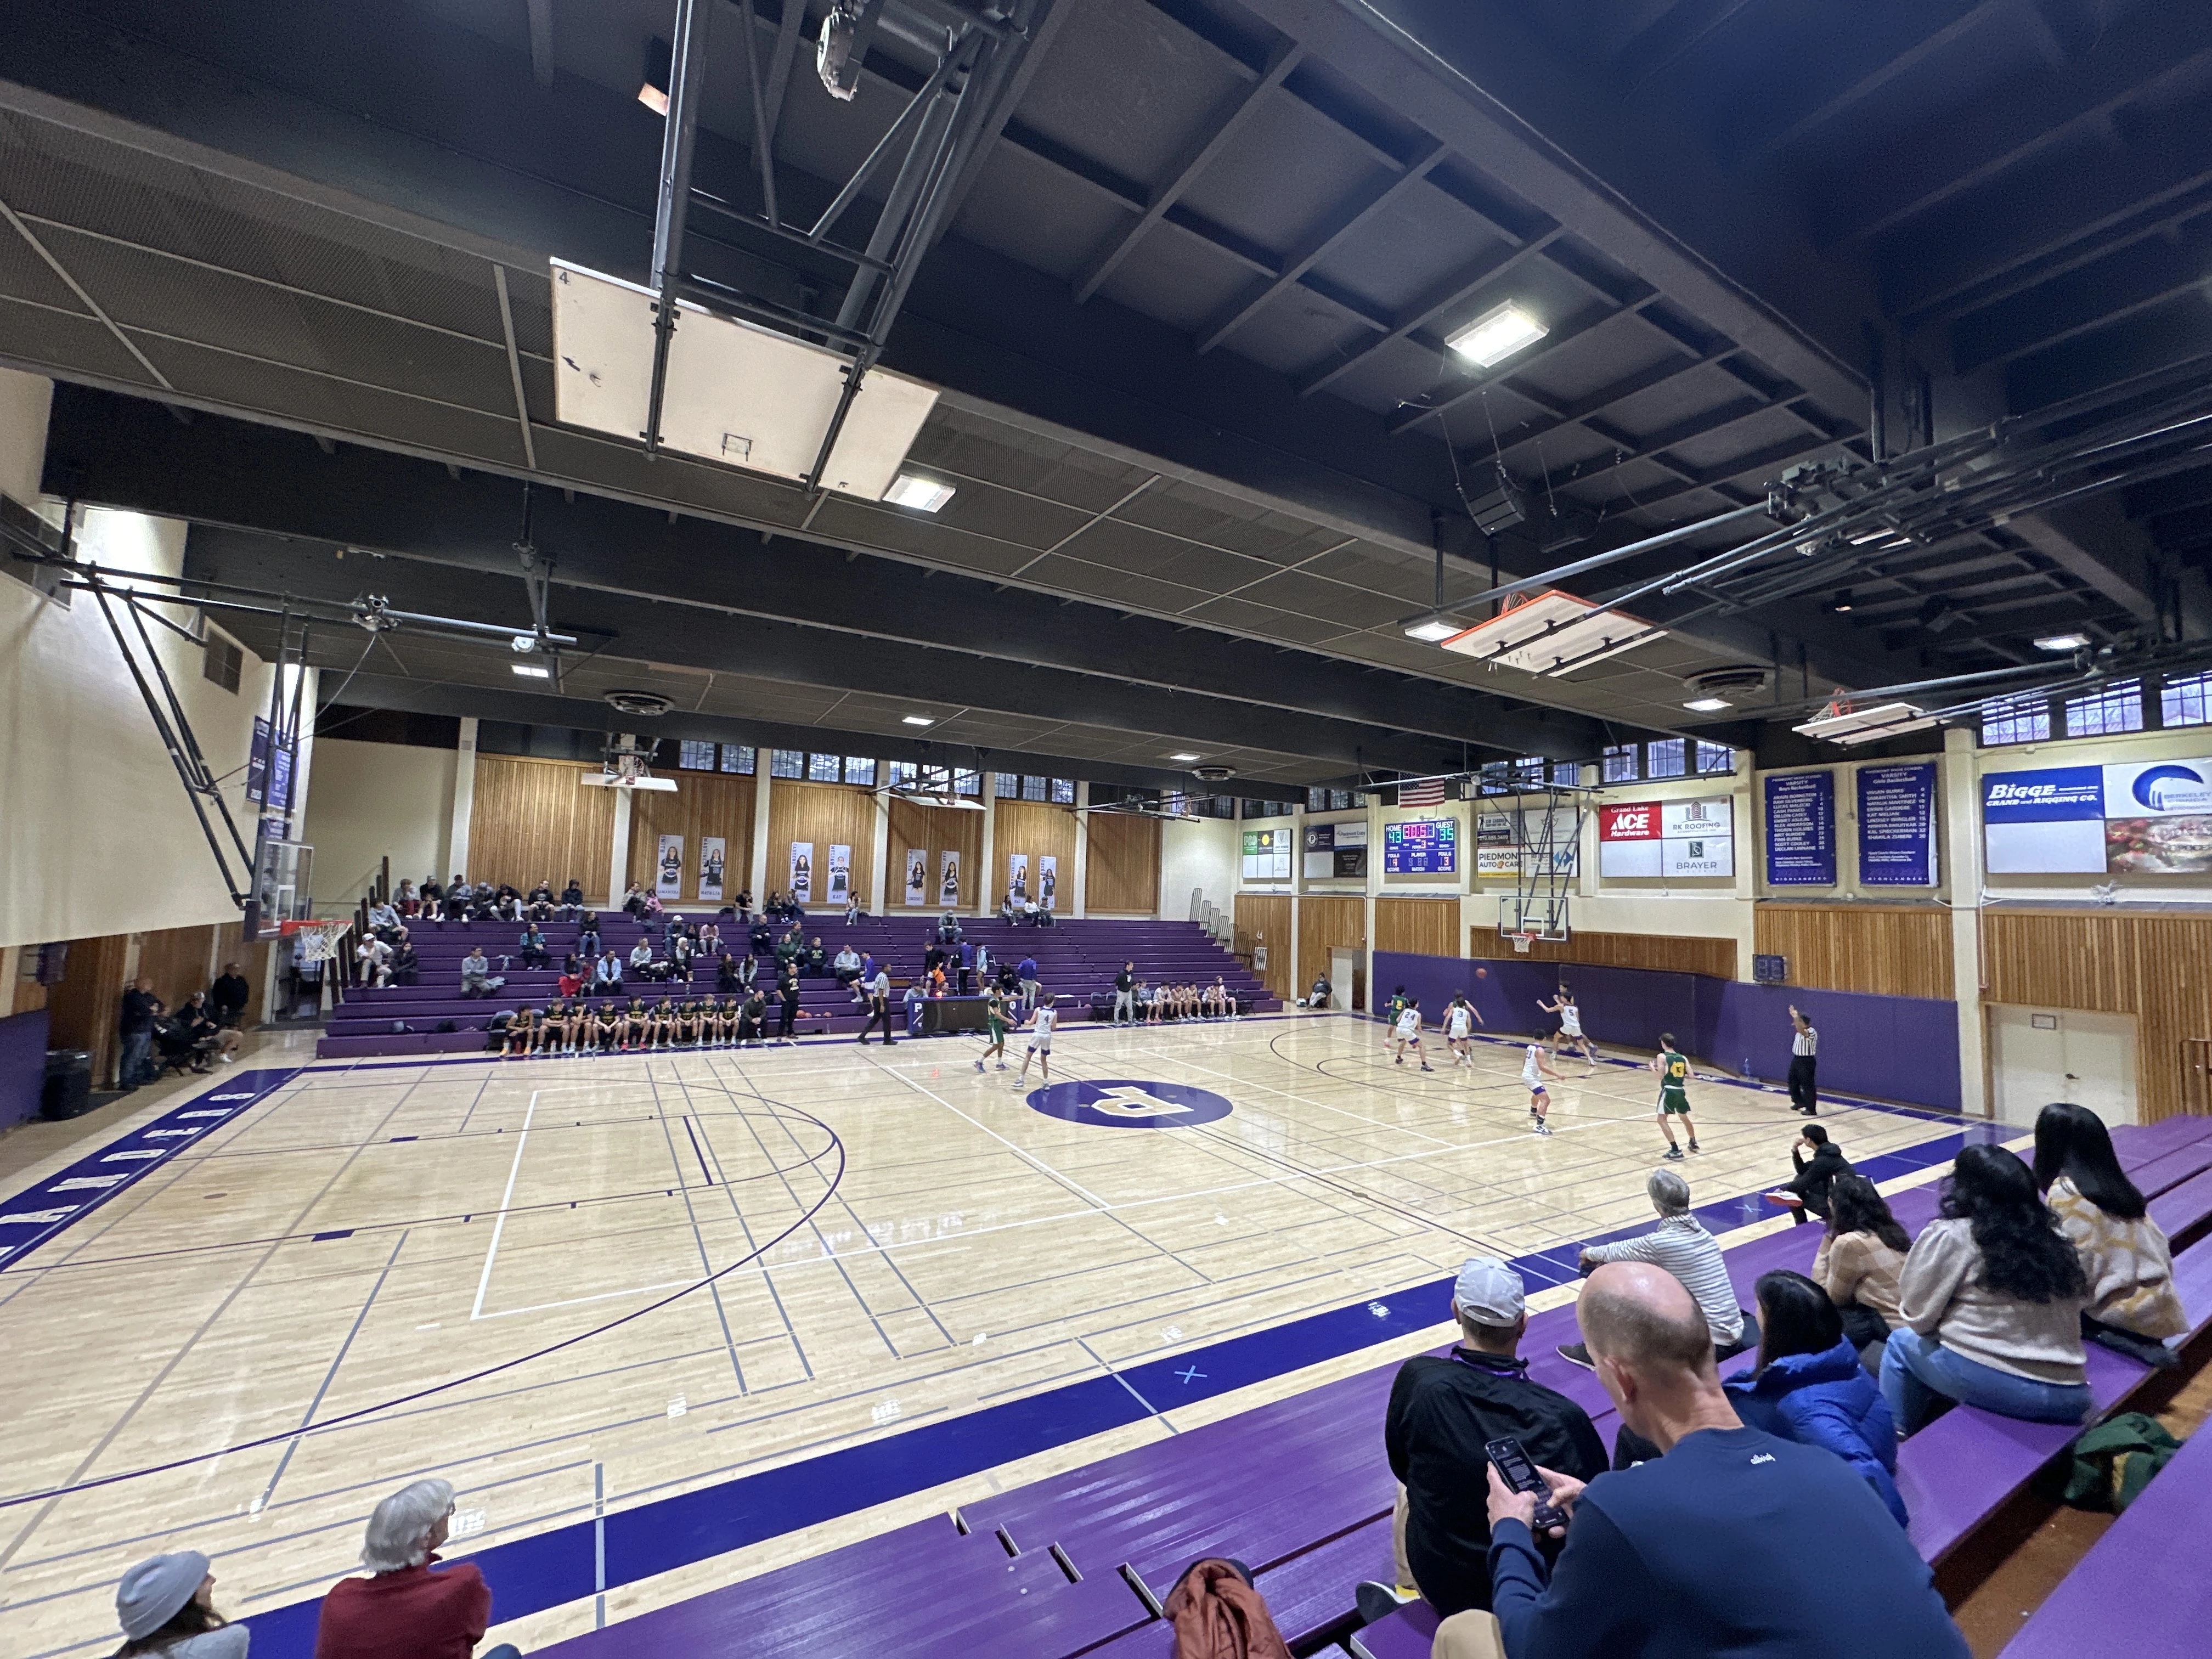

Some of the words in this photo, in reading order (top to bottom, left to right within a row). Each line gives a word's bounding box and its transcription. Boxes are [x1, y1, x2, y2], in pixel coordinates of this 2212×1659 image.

[558, 272, 569, 284] 4
[2033, 795, 2078, 804] RIGGING
[1610, 813, 1650, 830] ACE
[1389, 831, 1402, 843] 43
[1439, 828, 1454, 841] 35
[1443, 856, 1449, 866] 3
[1479, 852, 1521, 860] PIEDMON
[1676, 861, 1717, 870] BRAYER
[914, 1002, 922, 1013] P
[1044, 1014, 1049, 1023] 4
[1405, 1012, 1415, 1020] 24
